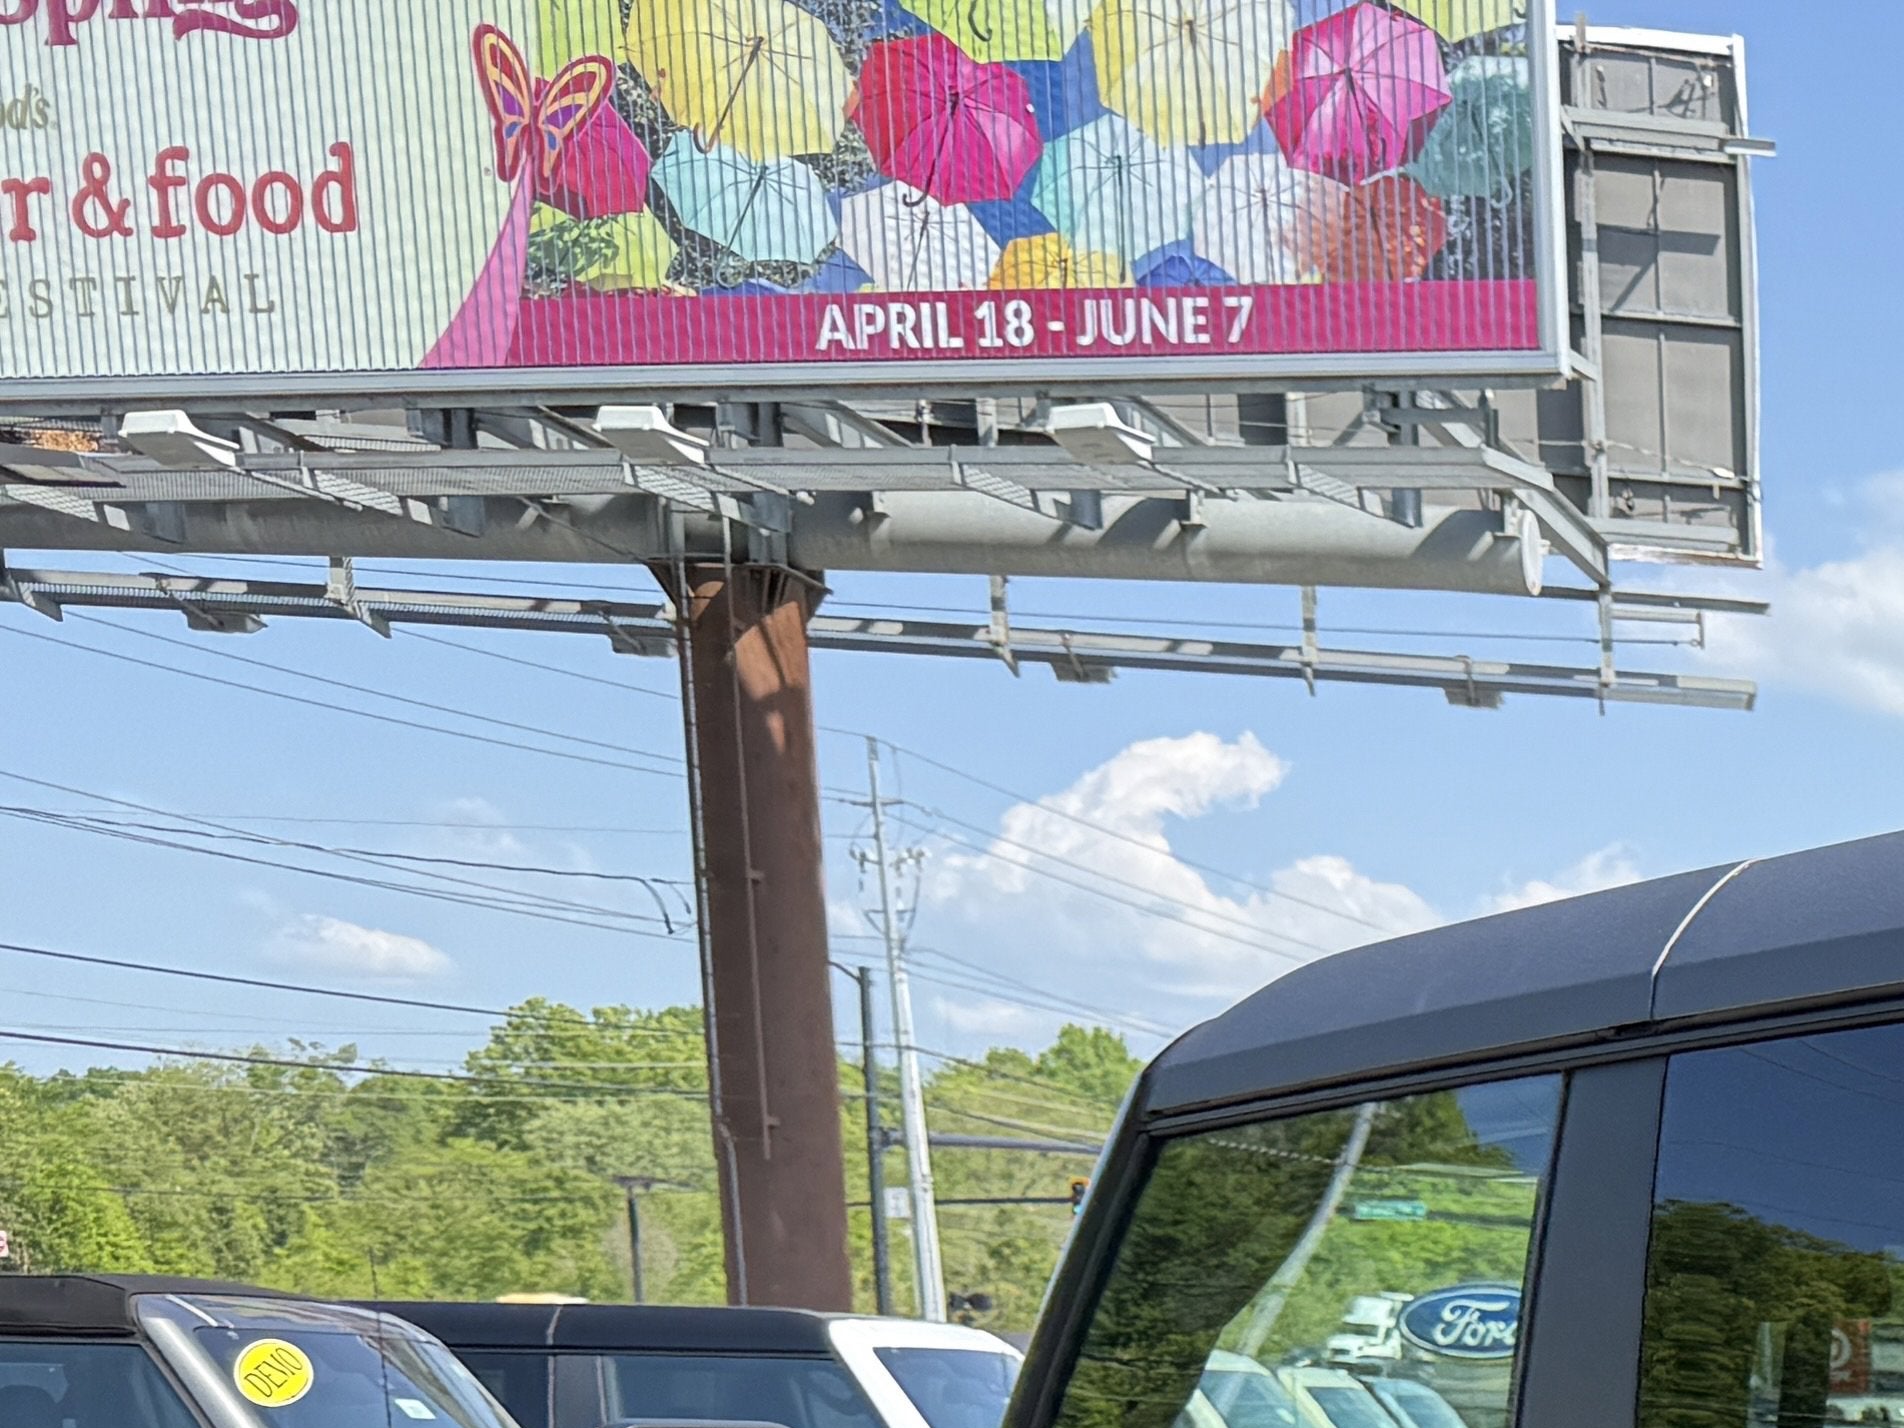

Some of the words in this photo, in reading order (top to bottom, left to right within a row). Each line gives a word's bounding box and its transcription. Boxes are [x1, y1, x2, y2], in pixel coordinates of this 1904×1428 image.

[72, 152, 134, 238] &
[147, 141, 357, 239] food
[815, 301, 964, 351] APRIL
[974, 299, 1034, 348] 18
[1077, 297, 1210, 346] JUNE
[1224, 296, 1253, 343] 7
[243, 1347, 303, 1398] DEMO
